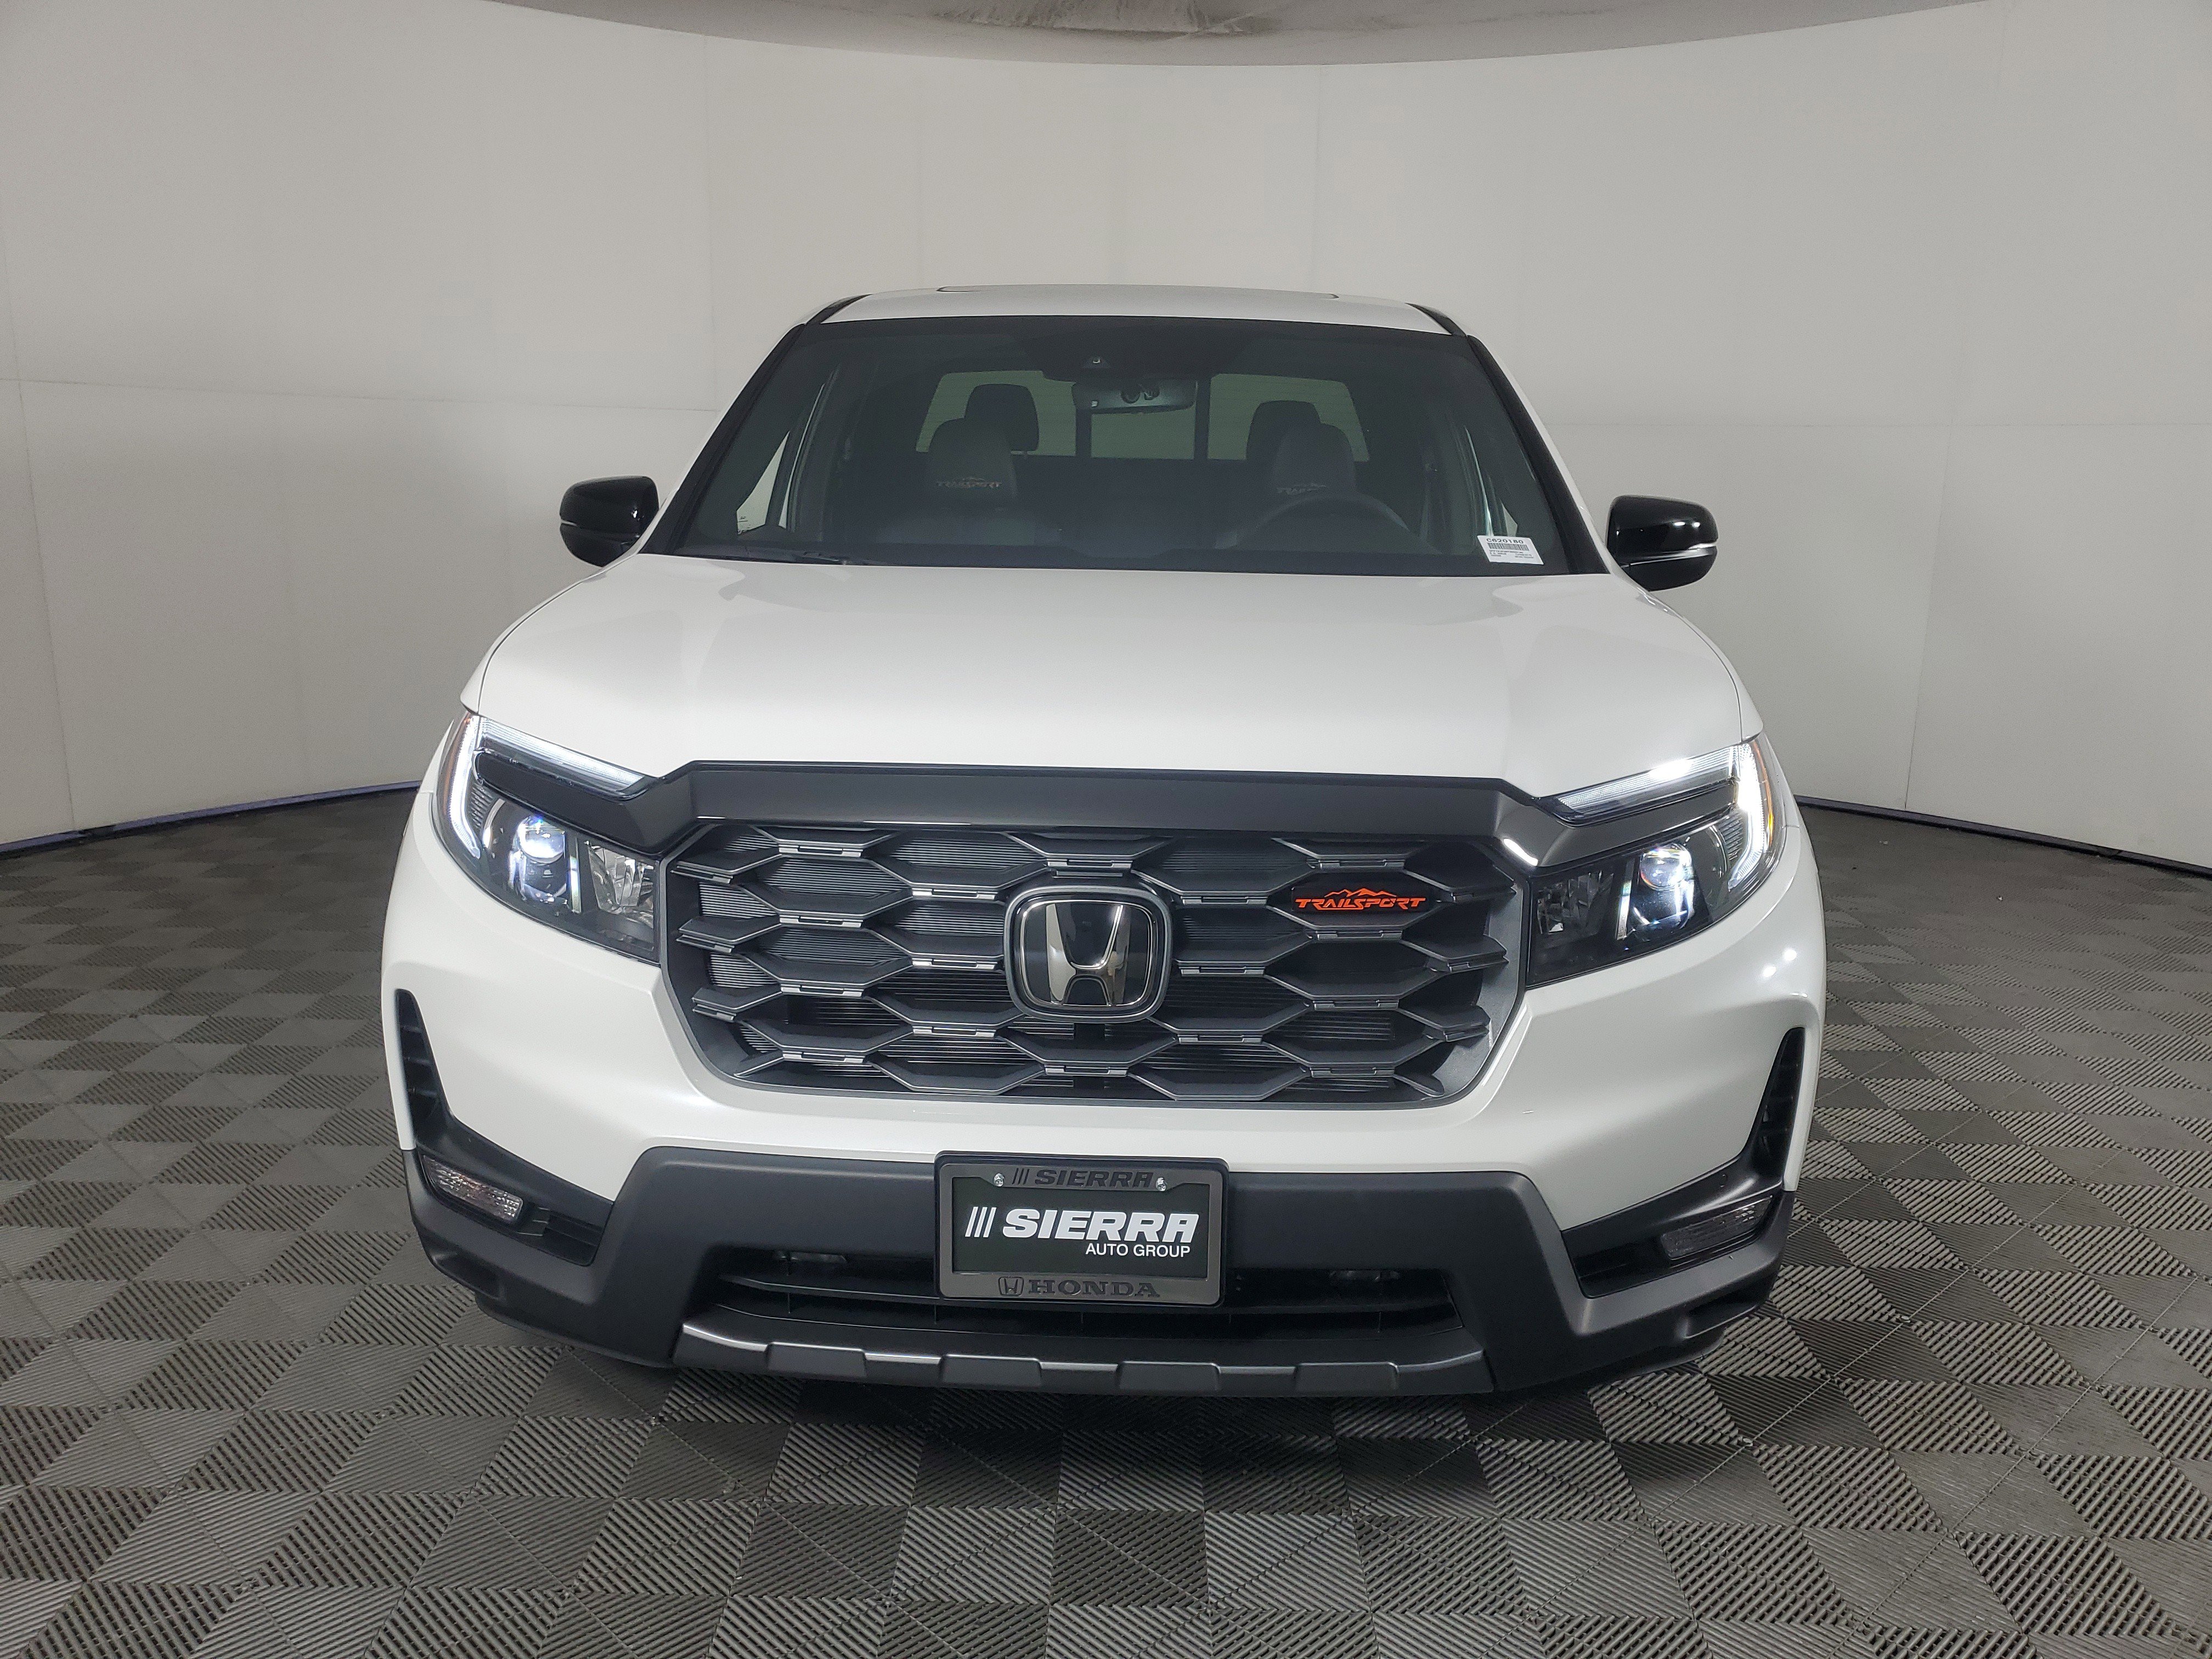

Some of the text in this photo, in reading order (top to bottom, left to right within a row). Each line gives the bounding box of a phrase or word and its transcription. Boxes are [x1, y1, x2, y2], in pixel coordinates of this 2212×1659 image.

[1295, 898, 1426, 910] TRAILSPORT
[1035, 1169, 1154, 1188] SIERRA
[1002, 1208, 1199, 1243] SIERRA
[1085, 1243, 1190, 1258] AUTO GROUP
[1029, 1279, 1160, 1298] HONDA
